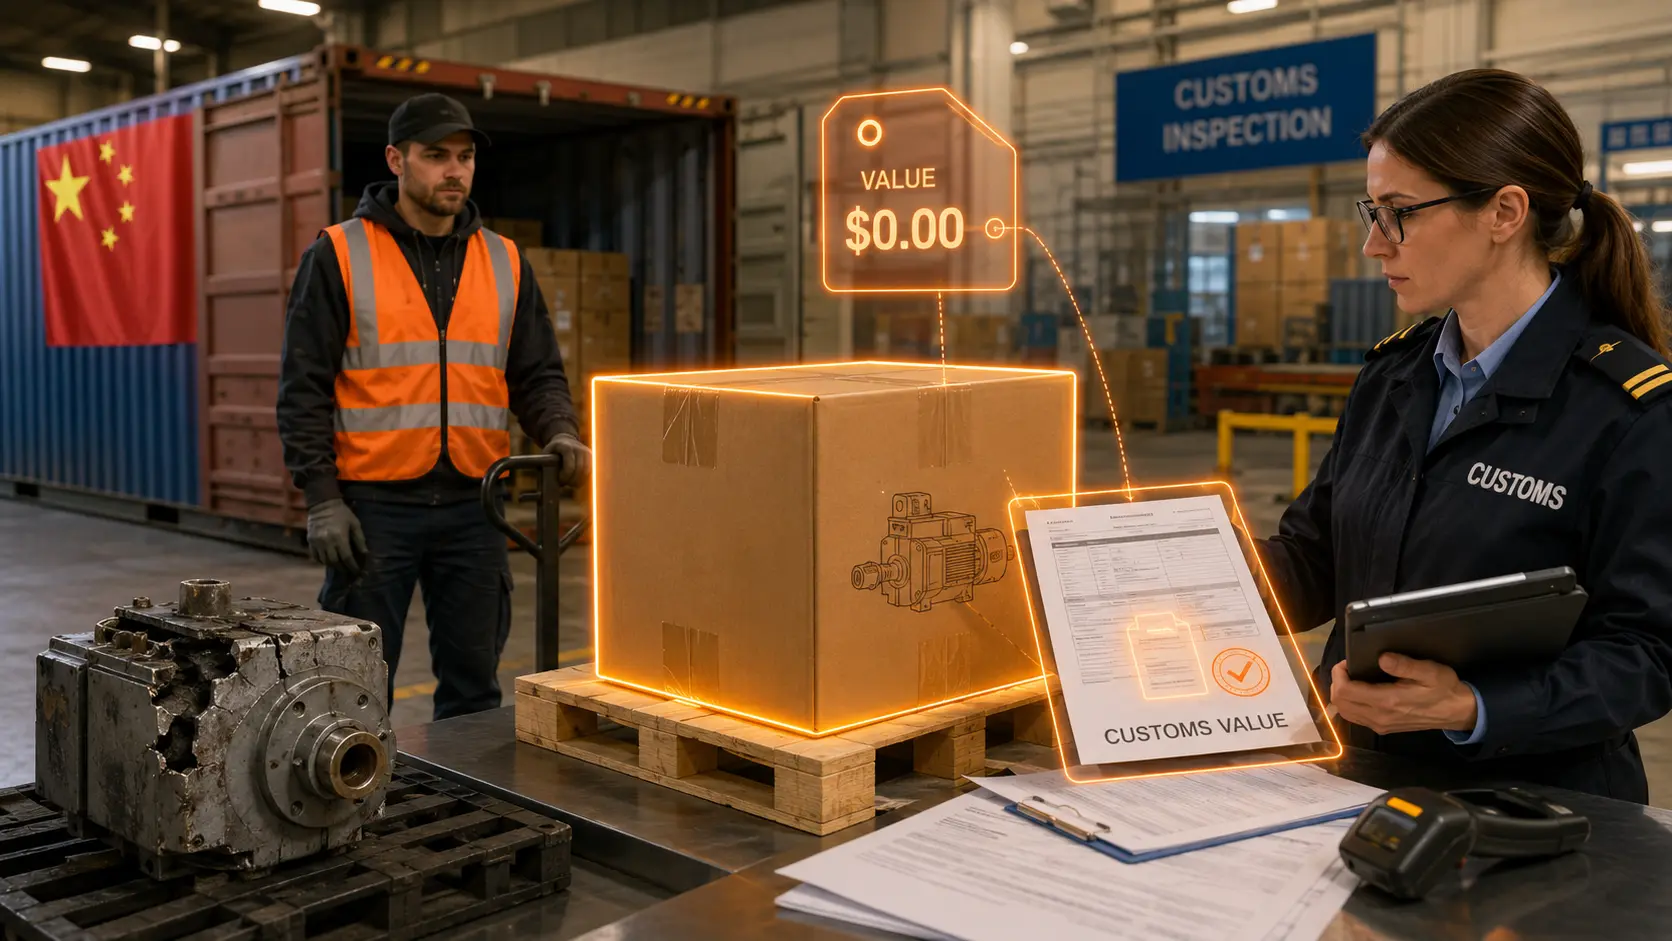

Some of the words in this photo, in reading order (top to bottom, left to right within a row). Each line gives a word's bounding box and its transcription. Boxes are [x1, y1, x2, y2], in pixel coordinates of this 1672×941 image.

[1174, 63, 1318, 110] CUSTOMS
[1162, 105, 1332, 154] INSPECTION
[1467, 462, 1567, 510] CUSTOMS
[1104, 720, 1212, 744] CUSTOMS
[1217, 712, 1289, 733] VALUE
